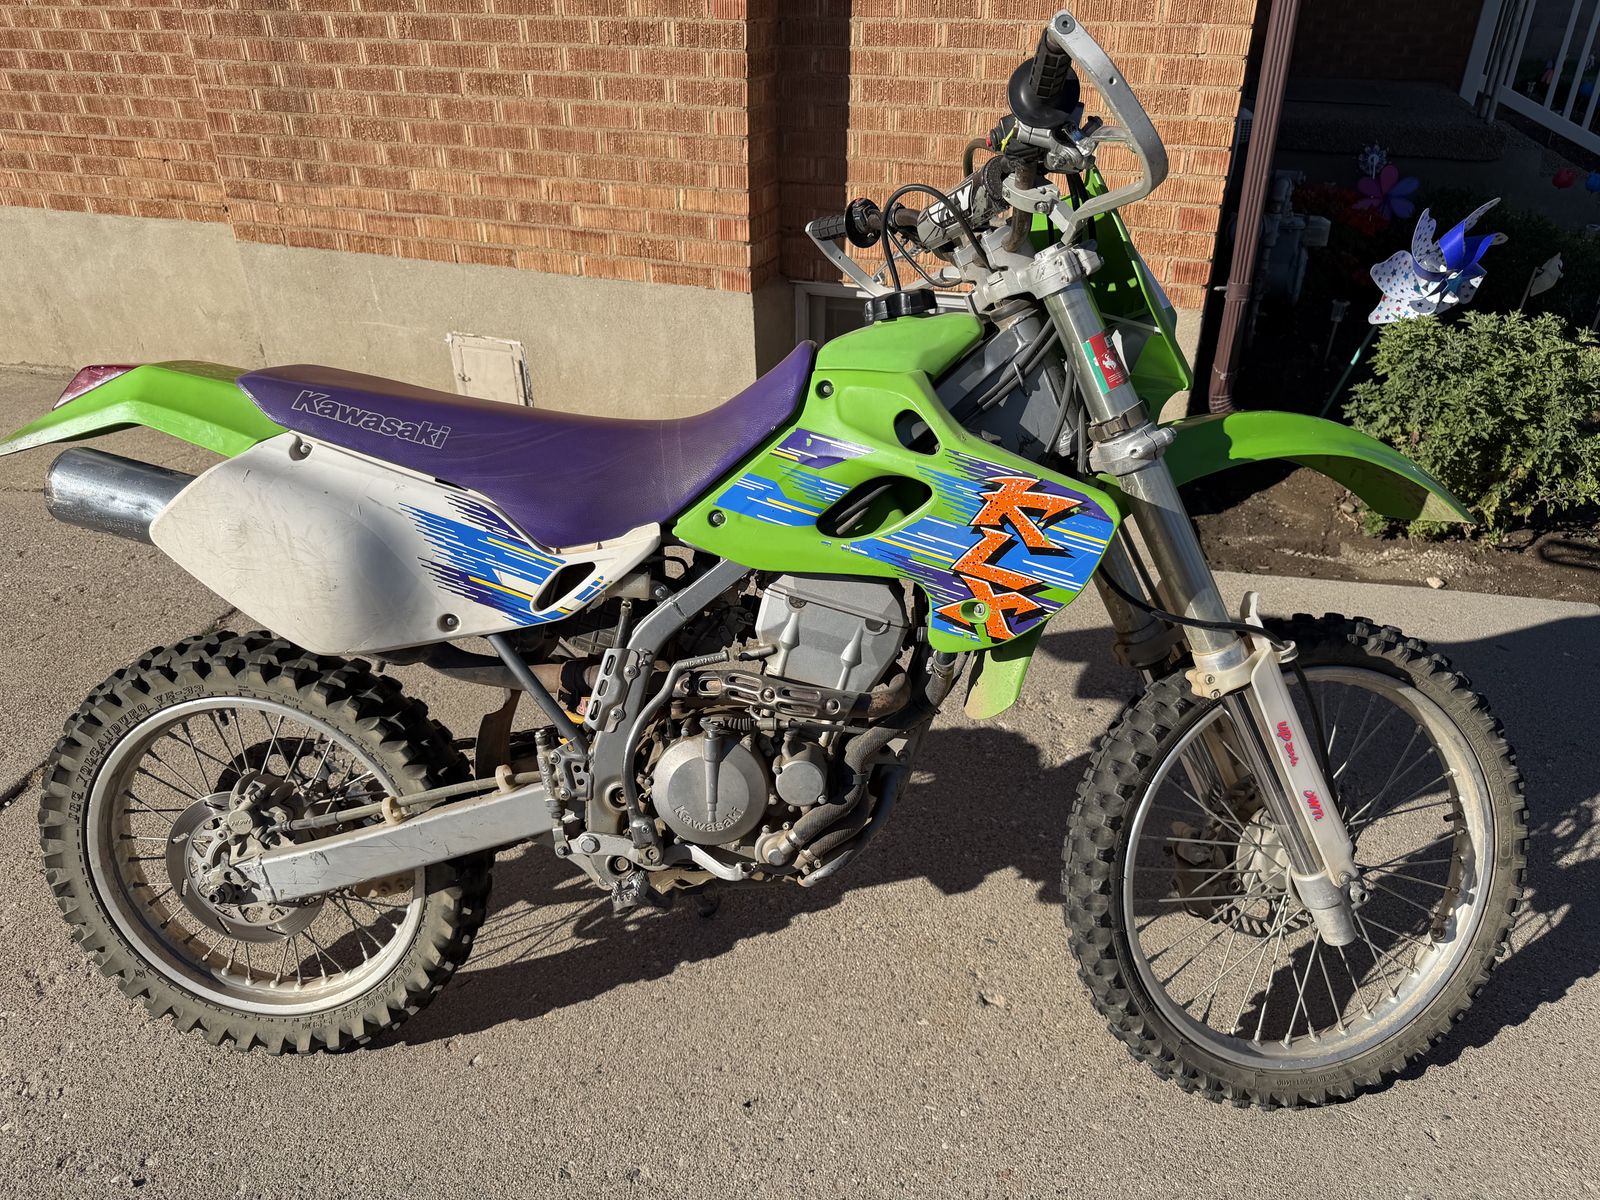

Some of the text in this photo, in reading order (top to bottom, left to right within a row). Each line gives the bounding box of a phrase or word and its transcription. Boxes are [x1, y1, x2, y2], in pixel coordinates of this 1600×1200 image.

[291, 389, 452, 450] Kawasaki
[1455, 708, 1510, 808] STARCROSS
[673, 804, 745, 832] Kawasaki
